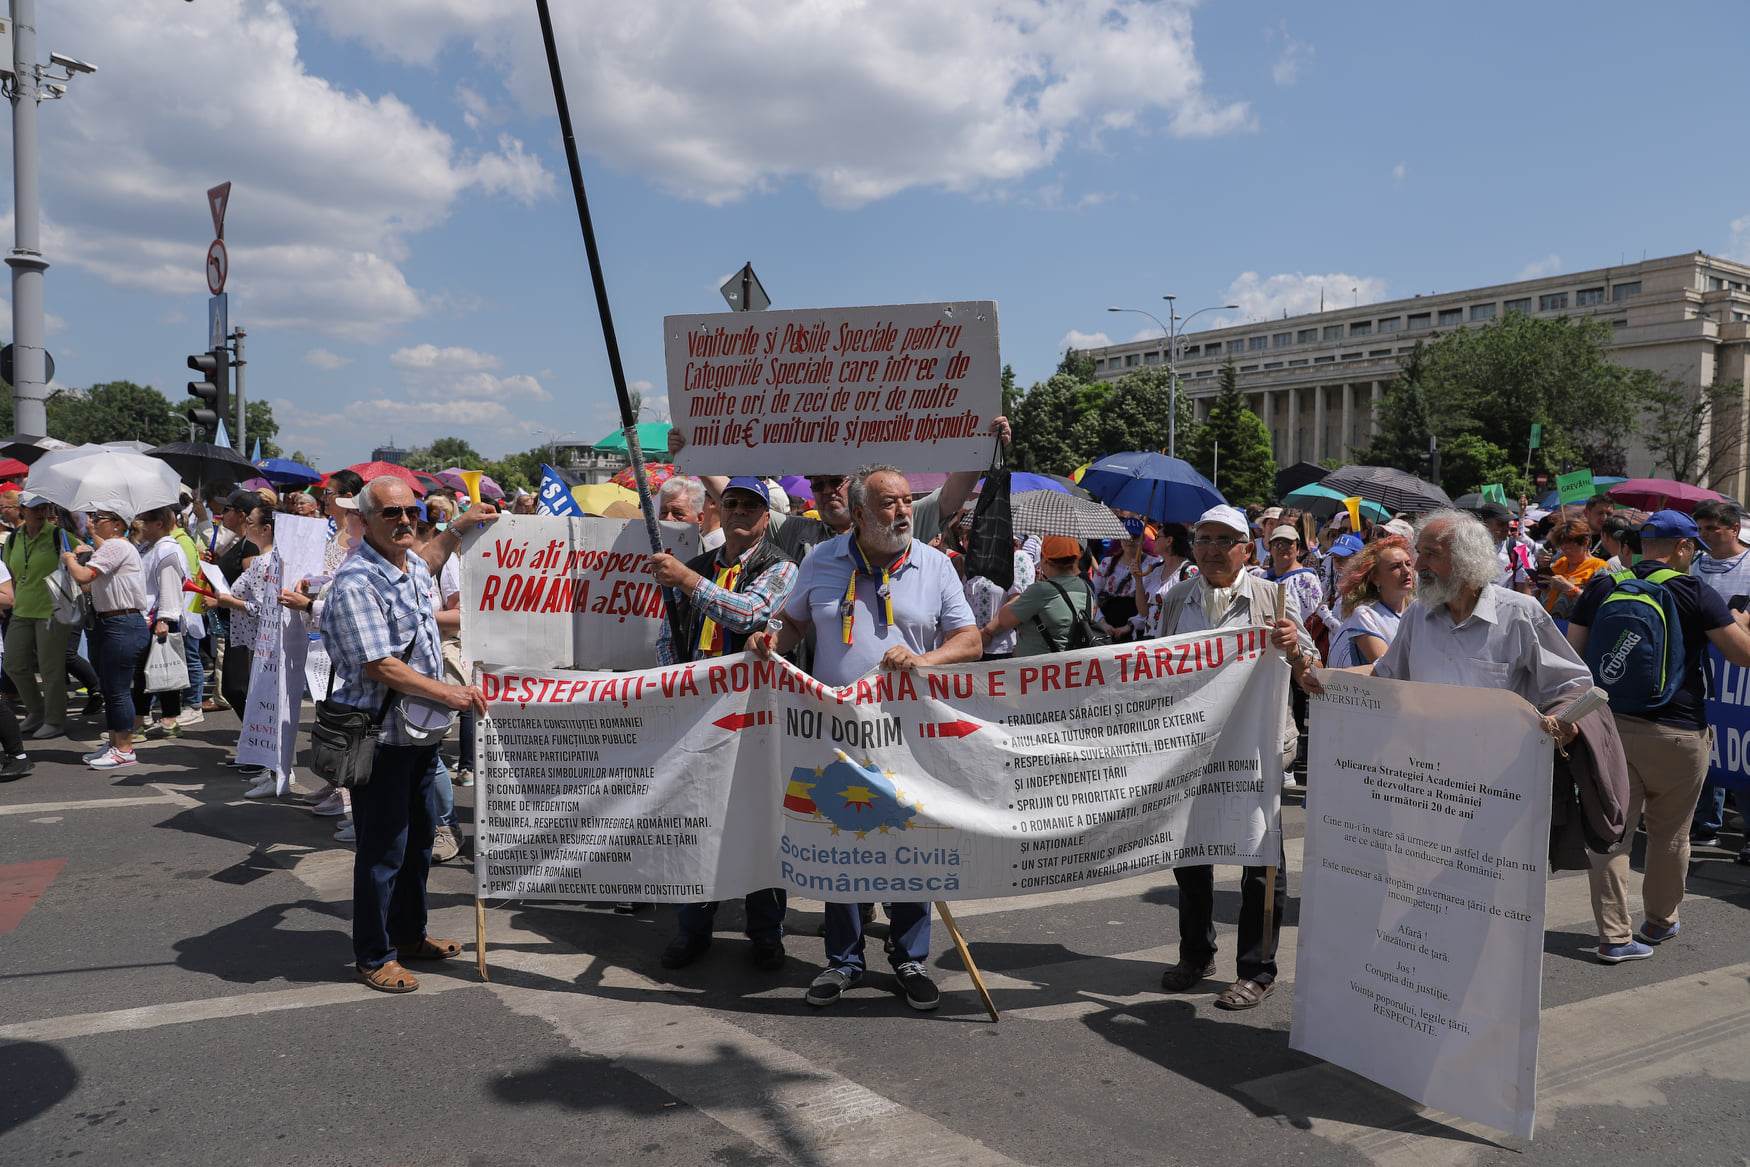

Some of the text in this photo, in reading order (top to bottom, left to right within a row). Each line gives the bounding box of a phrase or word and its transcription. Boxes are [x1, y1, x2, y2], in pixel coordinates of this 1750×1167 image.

[687, 325, 760, 358] Veniturile
[832, 320, 899, 358] Speciale
[899, 319, 963, 355] pentru
[684, 356, 764, 391] Categoriile
[765, 354, 834, 390] Speciale
[838, 359, 880, 384] care
[944, 350, 971, 381] de
[689, 390, 737, 418] multe
[770, 387, 791, 414] de
[793, 386, 831, 414] zeci
[830, 386, 851, 412] de
[884, 385, 908, 412] de
[908, 381, 960, 410] multe
[691, 418, 721, 447] mii
[762, 414, 840, 445] veniturile
[856, 411, 913, 449] pensiile
[561, 547, 673, 581] prospera
[1604, 631, 1642, 677] TUBORG
[481, 664, 699, 710] DEȘTEPTAȚI-VĂ
[928, 673, 974, 700] NU
[987, 670, 1007, 697] E
[1019, 657, 1106, 695] PREA
[1114, 636, 1225, 684] TÂRZIU
[485, 718, 542, 730] RESPECTAREA
[786, 707, 903, 749] NOI DORIM
[1007, 709, 1067, 727] ERADICAREA
[1011, 710, 1207, 749] ANULAREA TUTUROR DATORIILOR EXTERNE
[485, 734, 550, 746] DEPOLITIZAREA
[601, 732, 638, 745] PUBLICE
[486, 750, 538, 762] GUVERNARE
[1014, 750, 1080, 769] RESPECTAREA
[1408, 756, 1434, 770] Vrem
[487, 767, 608, 779] RESPECTAREA SIMBOLURILOR
[1334, 757, 1522, 802] Aplicarea Strategiei Academiei Române
[496, 783, 562, 796] CONDAMNAREA
[602, 784, 609, 796] A
[1016, 796, 1054, 812] SPRIJIN
[1056, 793, 1070, 808] CU
[1071, 787, 1127, 806] PRIORITATE
[1128, 782, 1164, 799] PENTRU
[1363, 775, 1482, 808] de dezvoltare a României
[487, 800, 581, 813] FORME DE IREDENTISM
[1383, 793, 1429, 810] următorii
[1431, 801, 1443, 812] 20
[1444, 805, 1457, 816] de
[1458, 810, 1475, 820] ani
[534, 817, 579, 830] RESPECTIV
[1019, 820, 1028, 833] O
[1077, 814, 1084, 827] A
[607, 833, 653, 847] NATURALE
[655, 833, 673, 846] ALE
[780, 834, 961, 866] Societatea Civilă
[1021, 859, 1035, 871] UN
[1037, 856, 1060, 869] STAT
[1061, 849, 1106, 866] PUTERNIC
[1117, 831, 1174, 855] RESPONSABIL
[1322, 814, 1342, 827] Cine
[1372, 826, 1394, 839] stare
[1406, 835, 1439, 850] urmeze
[1440, 844, 1452, 854] un
[1454, 846, 1480, 860] astfel
[1481, 852, 1494, 864] de
[1495, 856, 1519, 869] plan
[1521, 862, 1537, 872] nu
[1343, 832, 1357, 843] are
[1358, 836, 1369, 845] ce
[1394, 843, 1403, 854] la
[1404, 848, 1454, 868] conducerea
[588, 851, 632, 863] CONFORM
[526, 881, 558, 894] SALARII
[559, 882, 598, 895] DECENTE
[598, 883, 642, 895] CONFORM
[781, 860, 961, 893] Românească
[1021, 870, 1085, 889] CONFISCAREA
[1086, 861, 1129, 880] AVERILOR
[1322, 857, 1340, 871] Este
[1340, 863, 1372, 879] necesar
[1416, 886, 1465, 906] guvernarea
[1488, 905, 1502, 916] de
[1504, 910, 1532, 922] către
[1418, 944, 1429, 955] de
[1400, 975, 1415, 990] din
[1372, 1003, 1438, 1037] RESPECTATE.
[1420, 1007, 1447, 1025] legile
